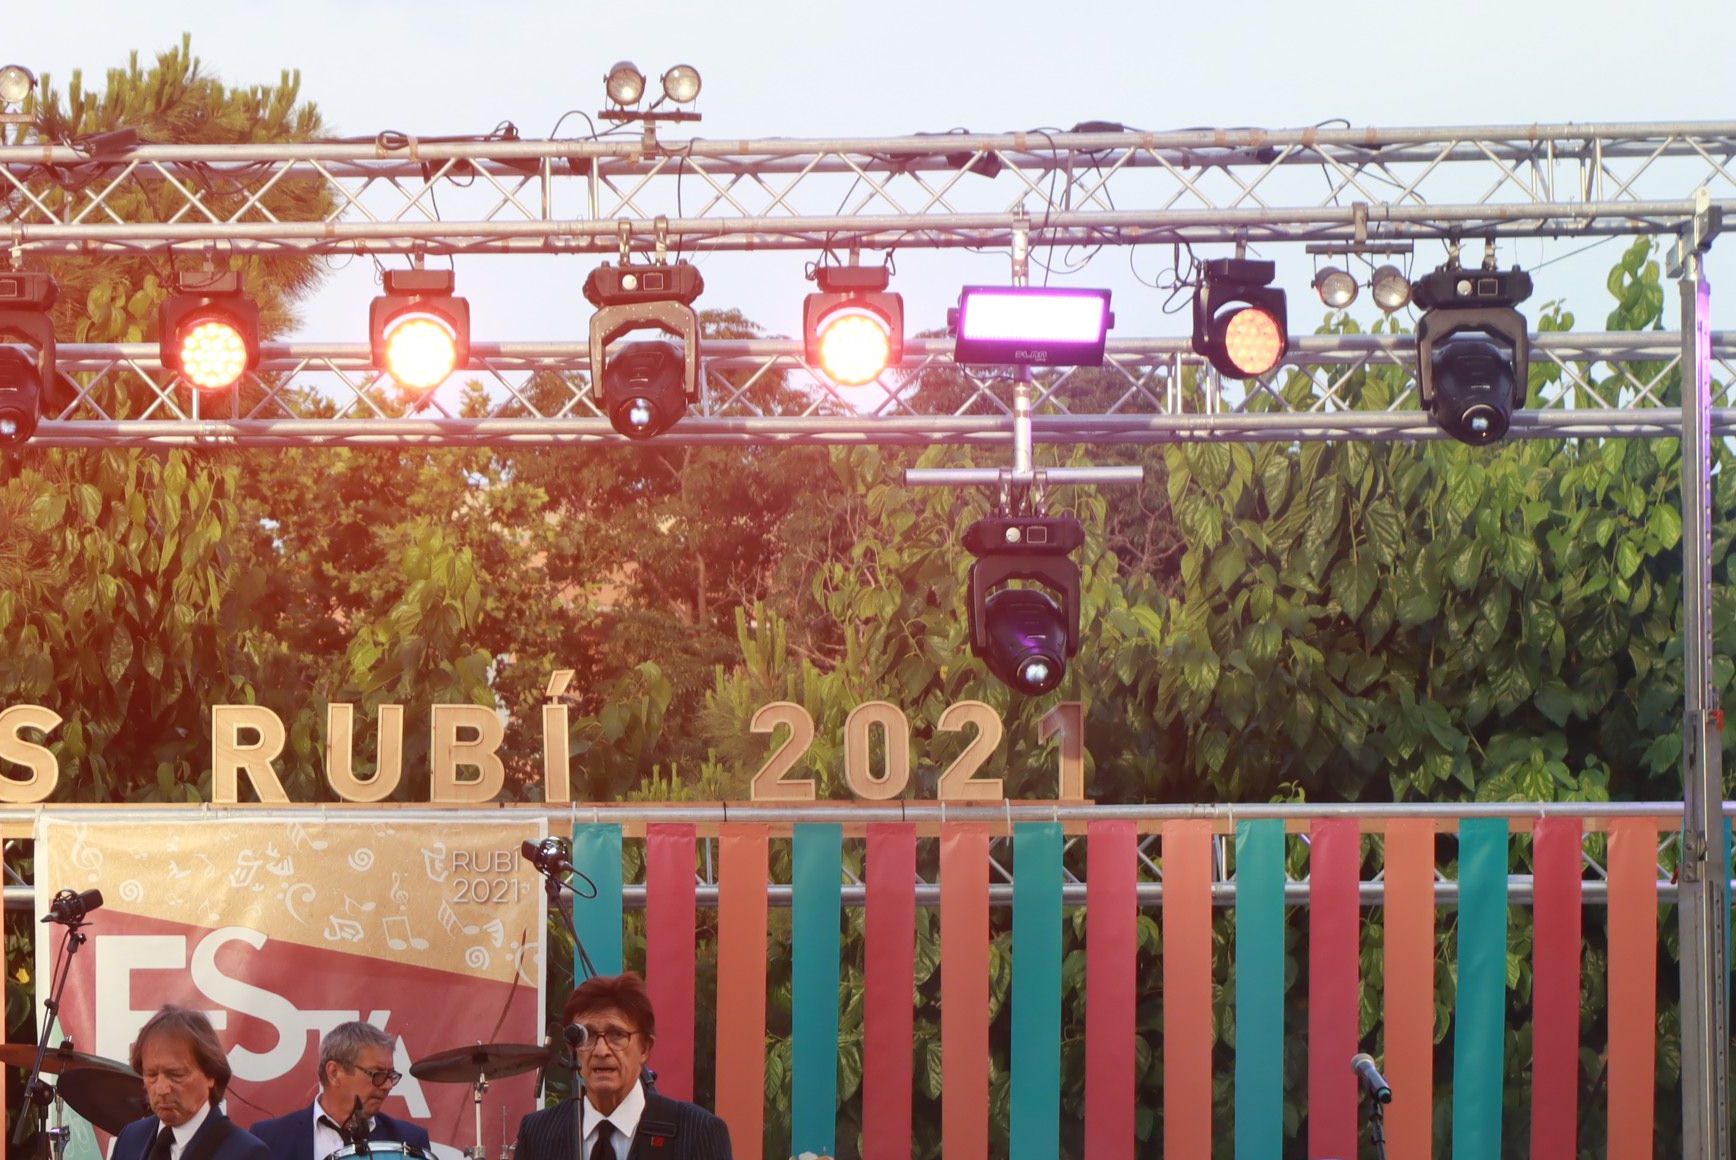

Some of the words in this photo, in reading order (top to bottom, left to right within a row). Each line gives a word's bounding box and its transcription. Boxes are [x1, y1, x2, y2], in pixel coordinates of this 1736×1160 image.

[211, 669, 574, 802] RUBÍ
[750, 700, 1085, 801] 2021
[451, 844, 522, 873] RUBÍ
[452, 877, 520, 903] 2021
